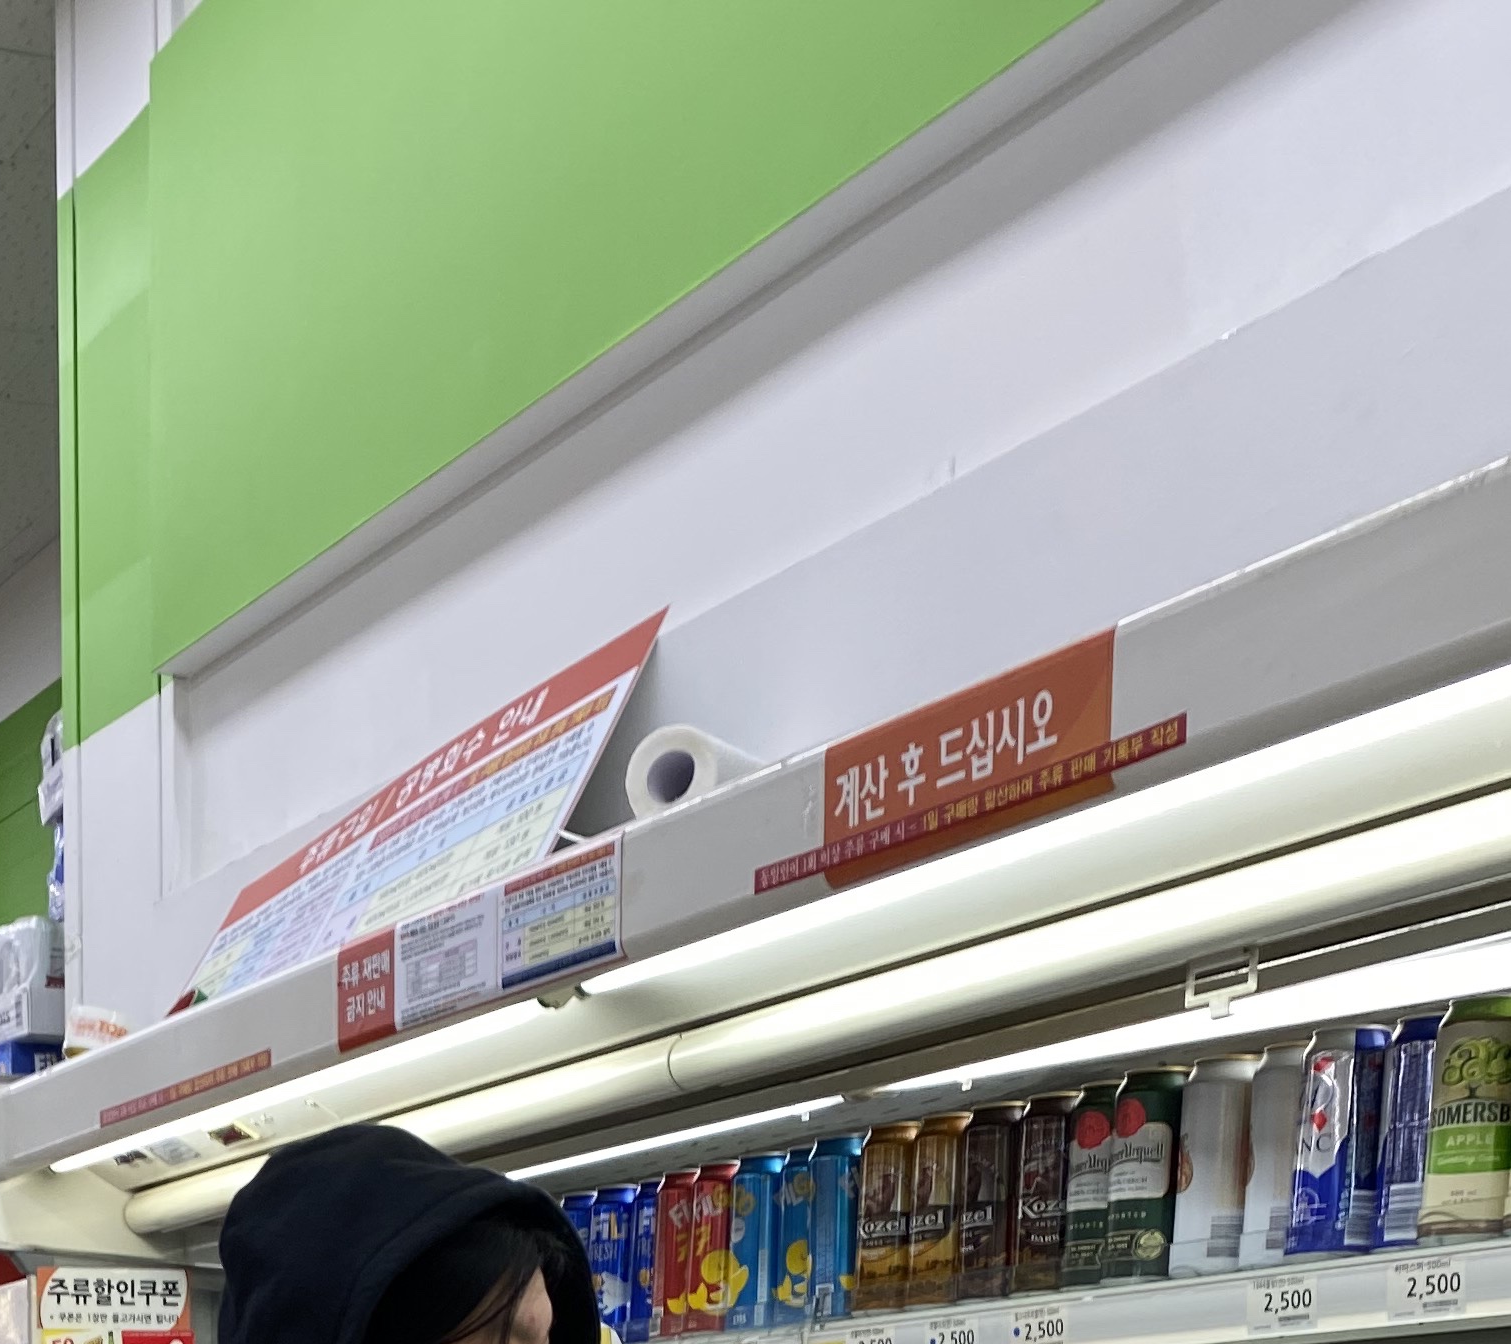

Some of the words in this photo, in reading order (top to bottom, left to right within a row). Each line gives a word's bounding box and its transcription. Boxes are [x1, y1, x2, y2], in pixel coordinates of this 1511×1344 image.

[835, 754, 888, 829] 계산
[897, 742, 926, 806] 후
[936, 689, 1058, 789] 드십시오
[1038, 762, 1063, 791] 주류
[1150, 718, 1178, 748] 작성
[342, 961, 359, 990] 주류
[346, 994, 365, 1023] 금지
[368, 986, 385, 1015] 안내
[1431, 1102, 1510, 1127] SOMERSB
[1446, 1131, 1492, 1148] APPLE
[48, 1278, 181, 1306] 주류할인쿠폰
[1407, 1272, 1461, 1299] 2,500
[1264, 1289, 1312, 1314] 2,500
[1024, 1319, 1064, 1341] 2,500
